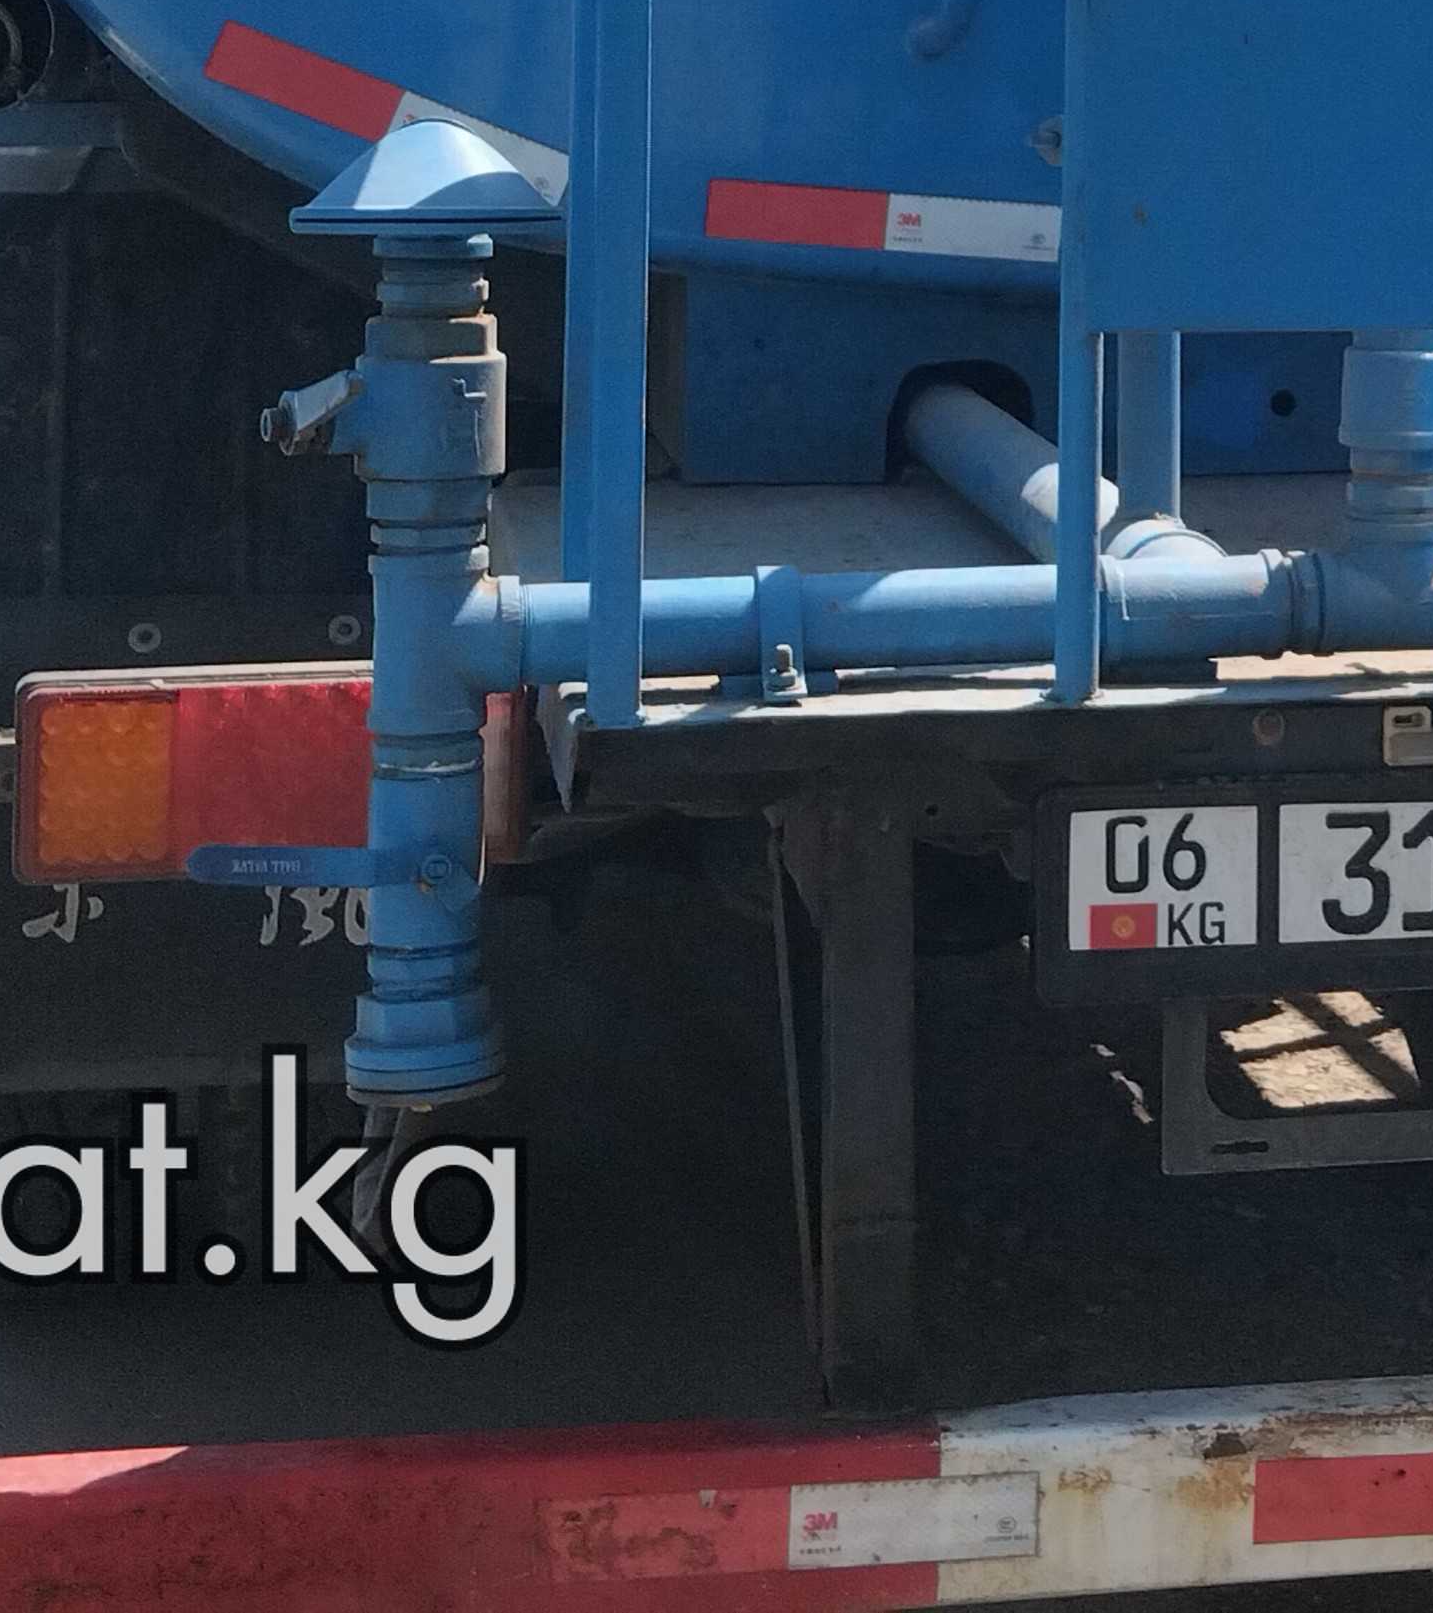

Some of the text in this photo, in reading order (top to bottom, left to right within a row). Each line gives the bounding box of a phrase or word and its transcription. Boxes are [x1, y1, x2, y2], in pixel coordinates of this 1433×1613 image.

[1105, 813, 1207, 894] 06
[1167, 902, 1226, 947] KG
[802, 1510, 839, 1532] 3M
